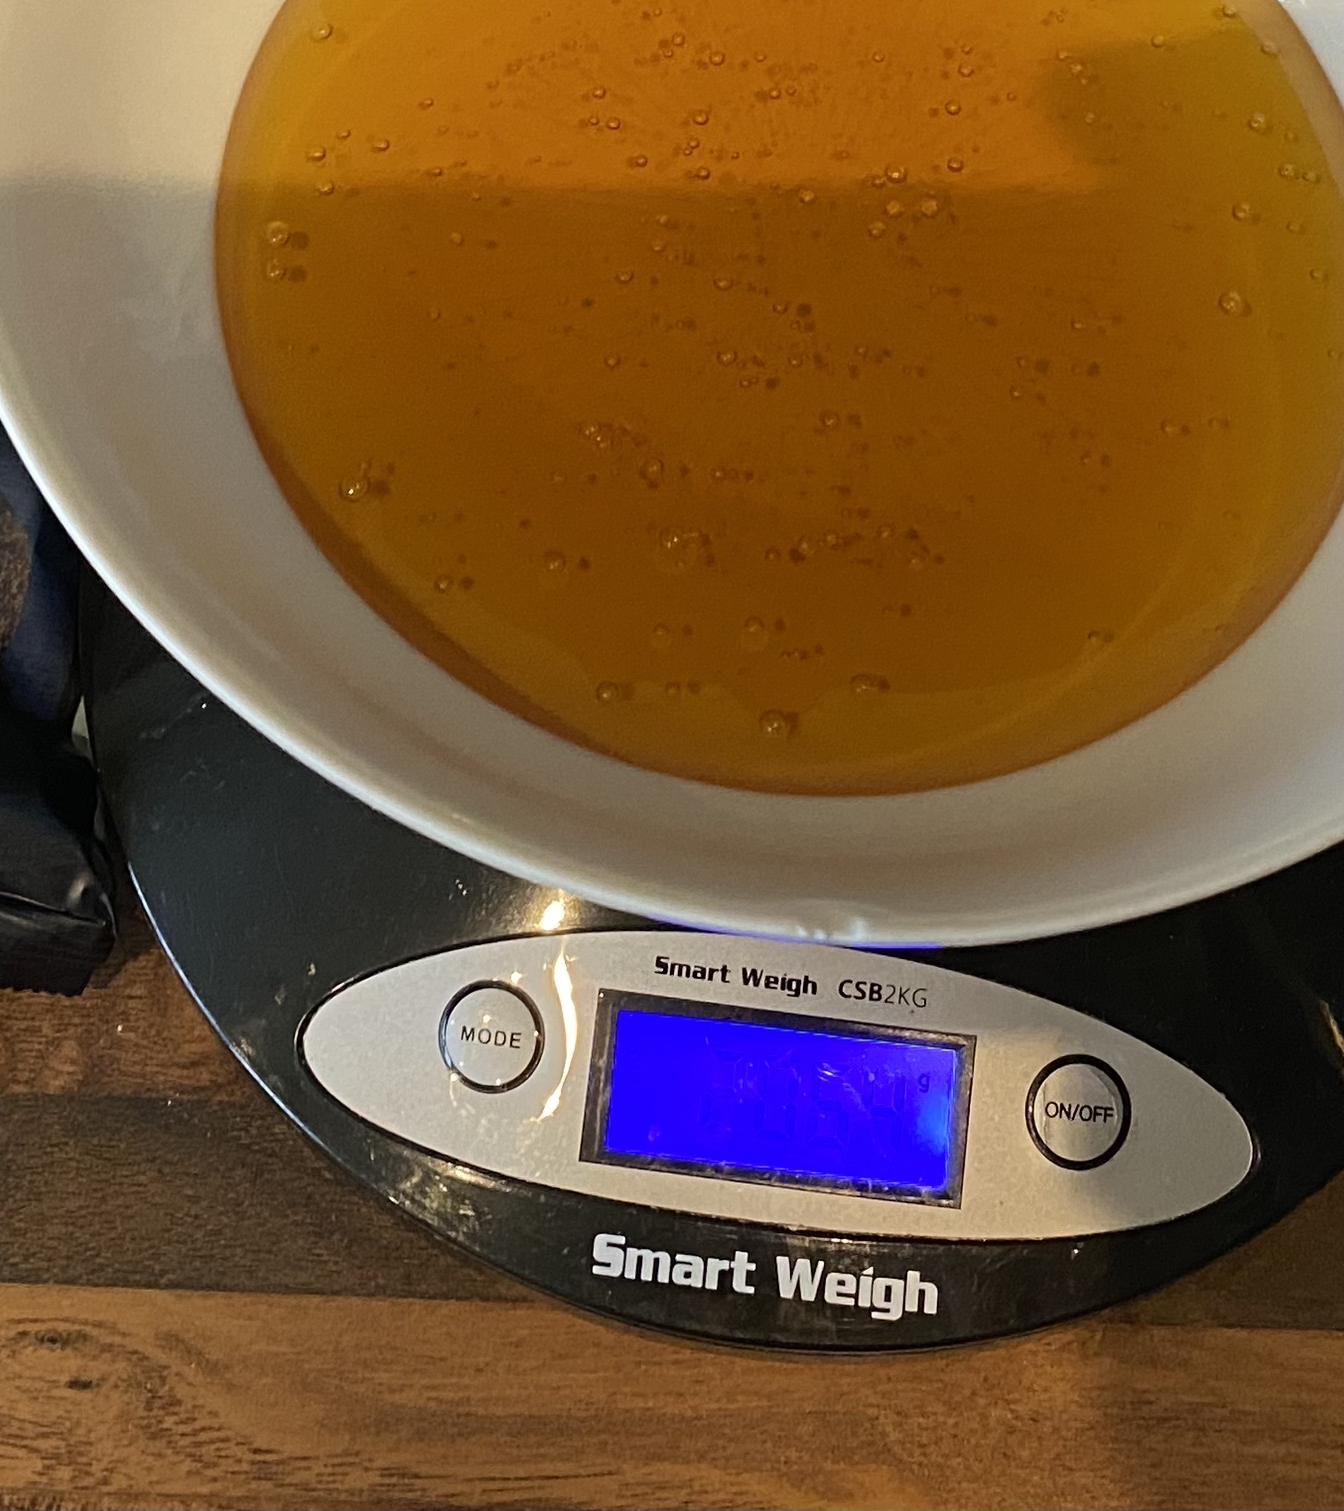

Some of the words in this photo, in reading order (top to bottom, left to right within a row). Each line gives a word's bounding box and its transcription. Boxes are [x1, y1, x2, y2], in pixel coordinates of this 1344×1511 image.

[654, 955, 731, 985] Smart
[741, 966, 818, 998] Weigh
[838, 978, 928, 1009] CSB2KG
[460, 1025, 522, 1049] MODE
[1044, 1100, 1114, 1124] ON/OFF
[591, 1232, 757, 1295] Smart
[775, 1254, 940, 1322] Weigh
